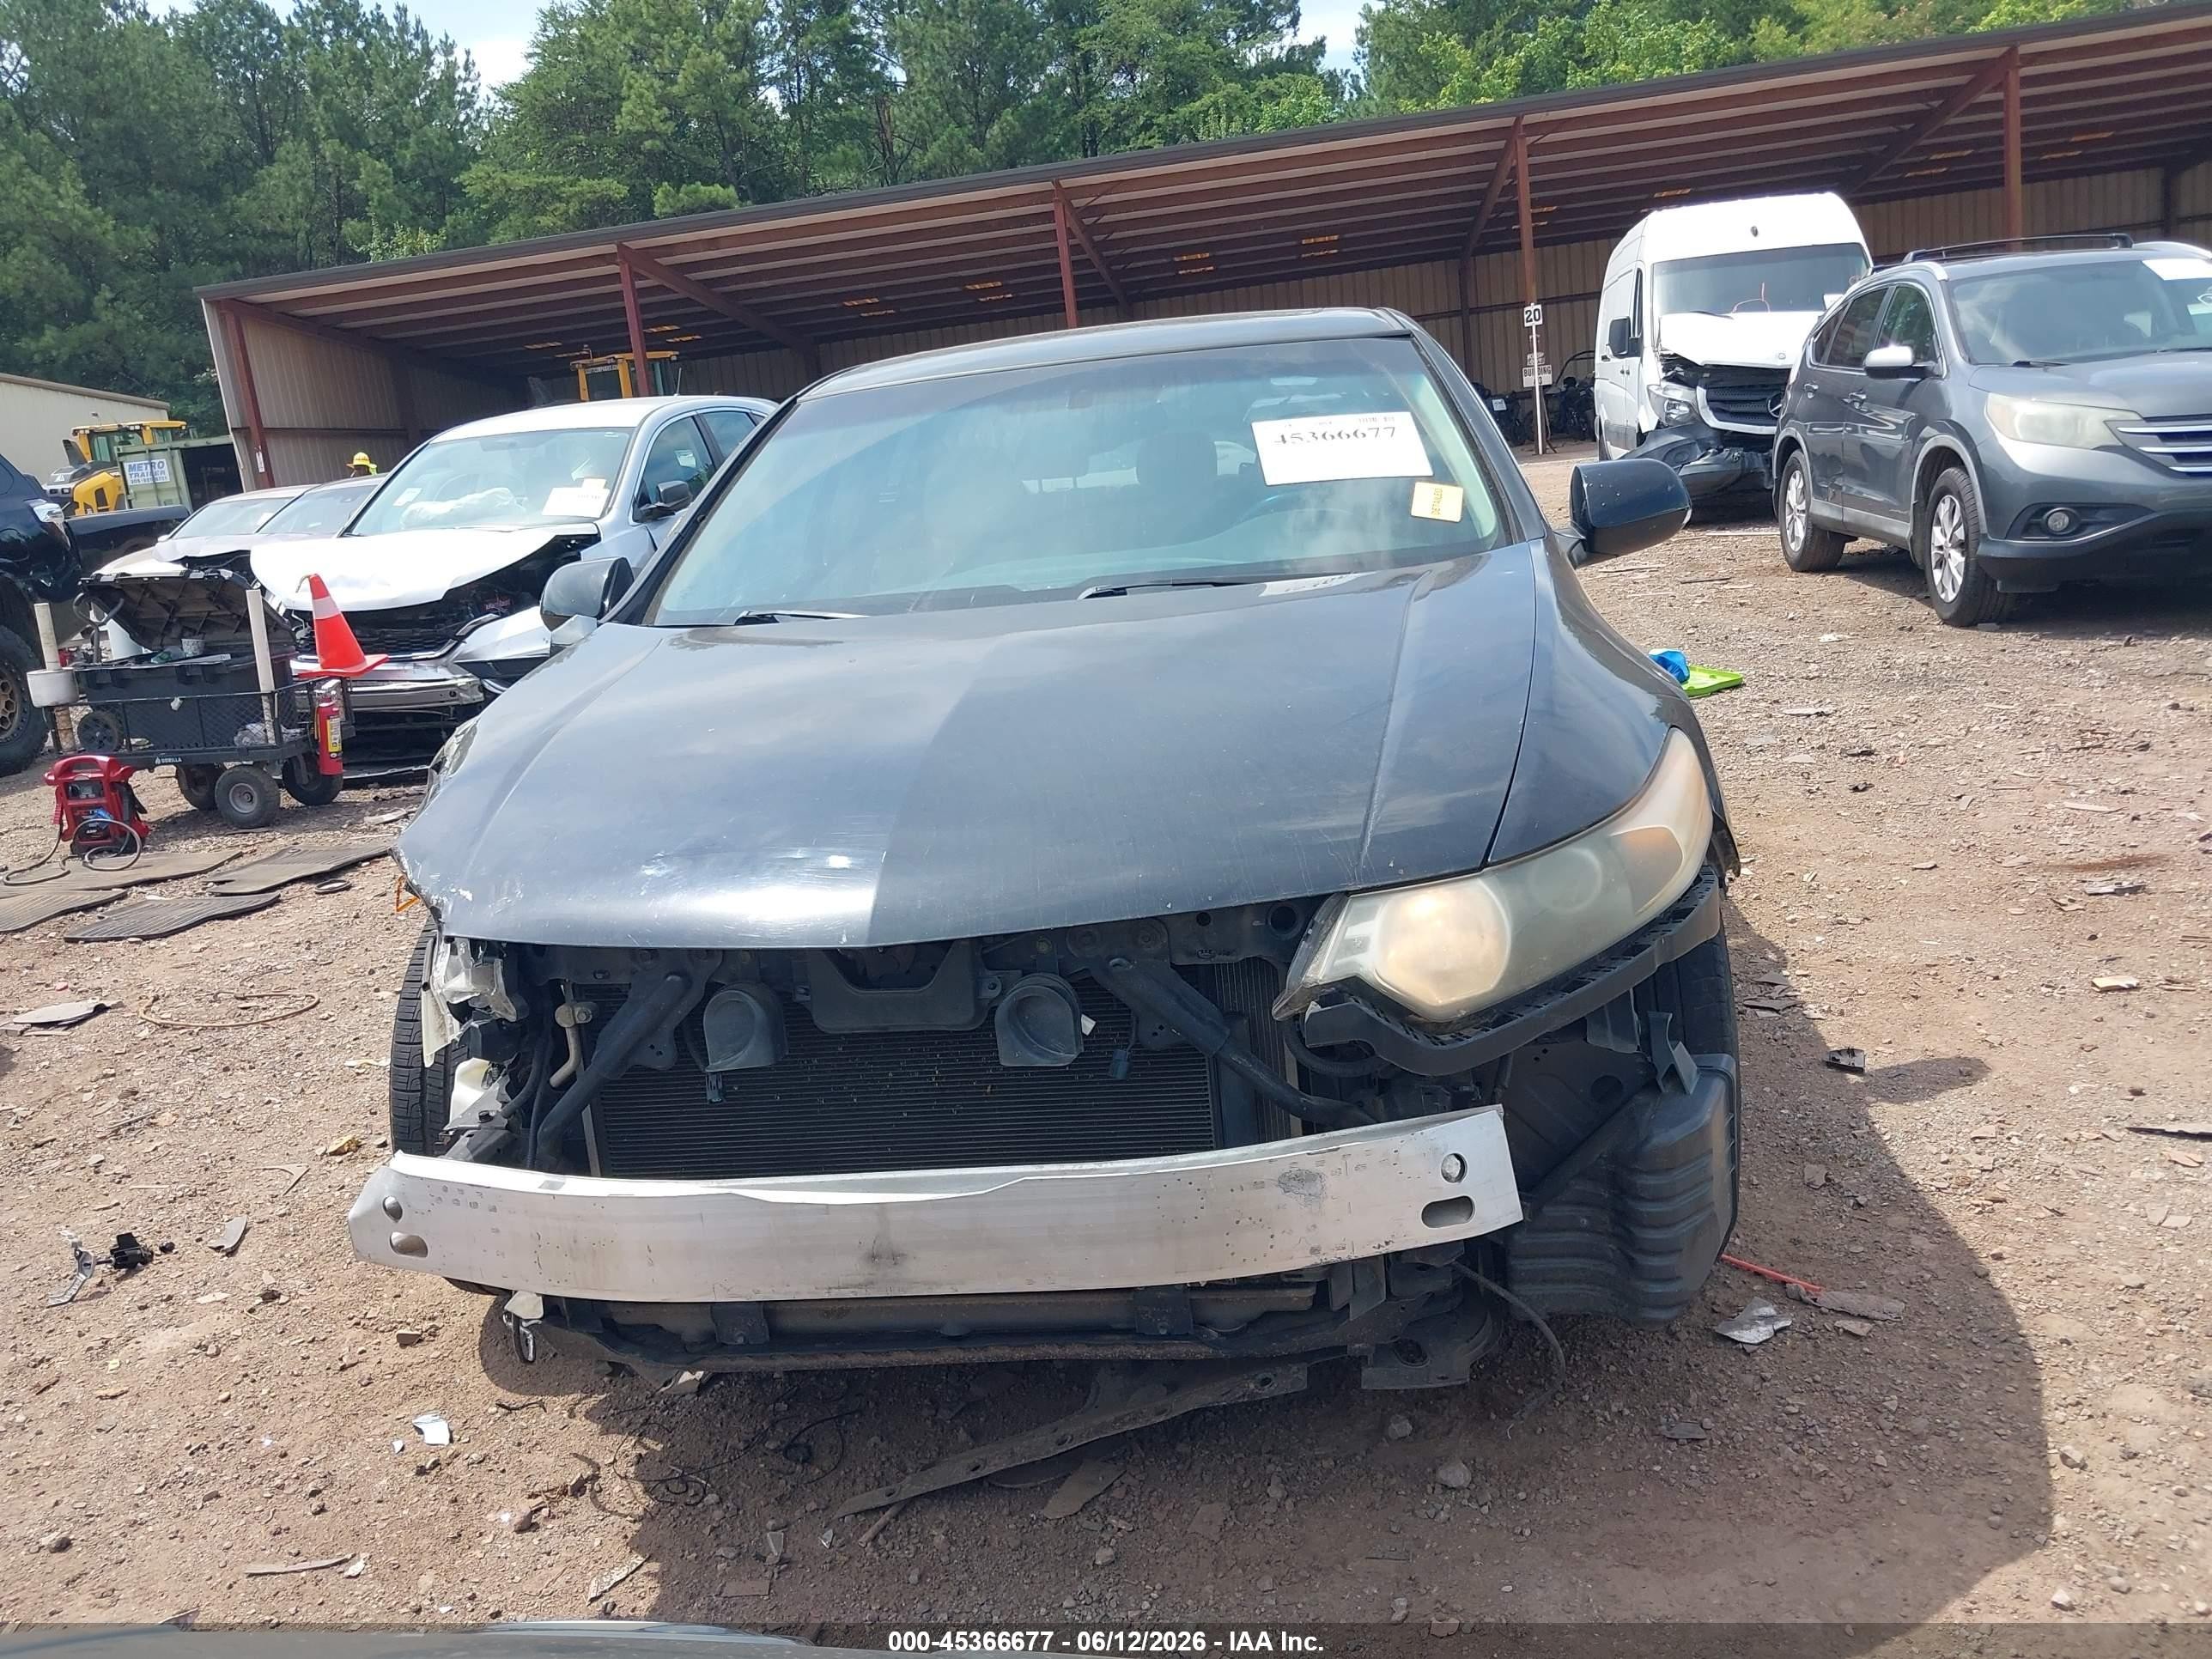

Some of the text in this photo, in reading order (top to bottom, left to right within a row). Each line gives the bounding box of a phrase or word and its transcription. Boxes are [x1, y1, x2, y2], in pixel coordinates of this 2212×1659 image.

[1525, 307, 1540, 323] 20
[1524, 367, 1551, 377] BUIDING
[1273, 426, 1395, 445] 45366677
[128, 460, 165, 473] METRO
